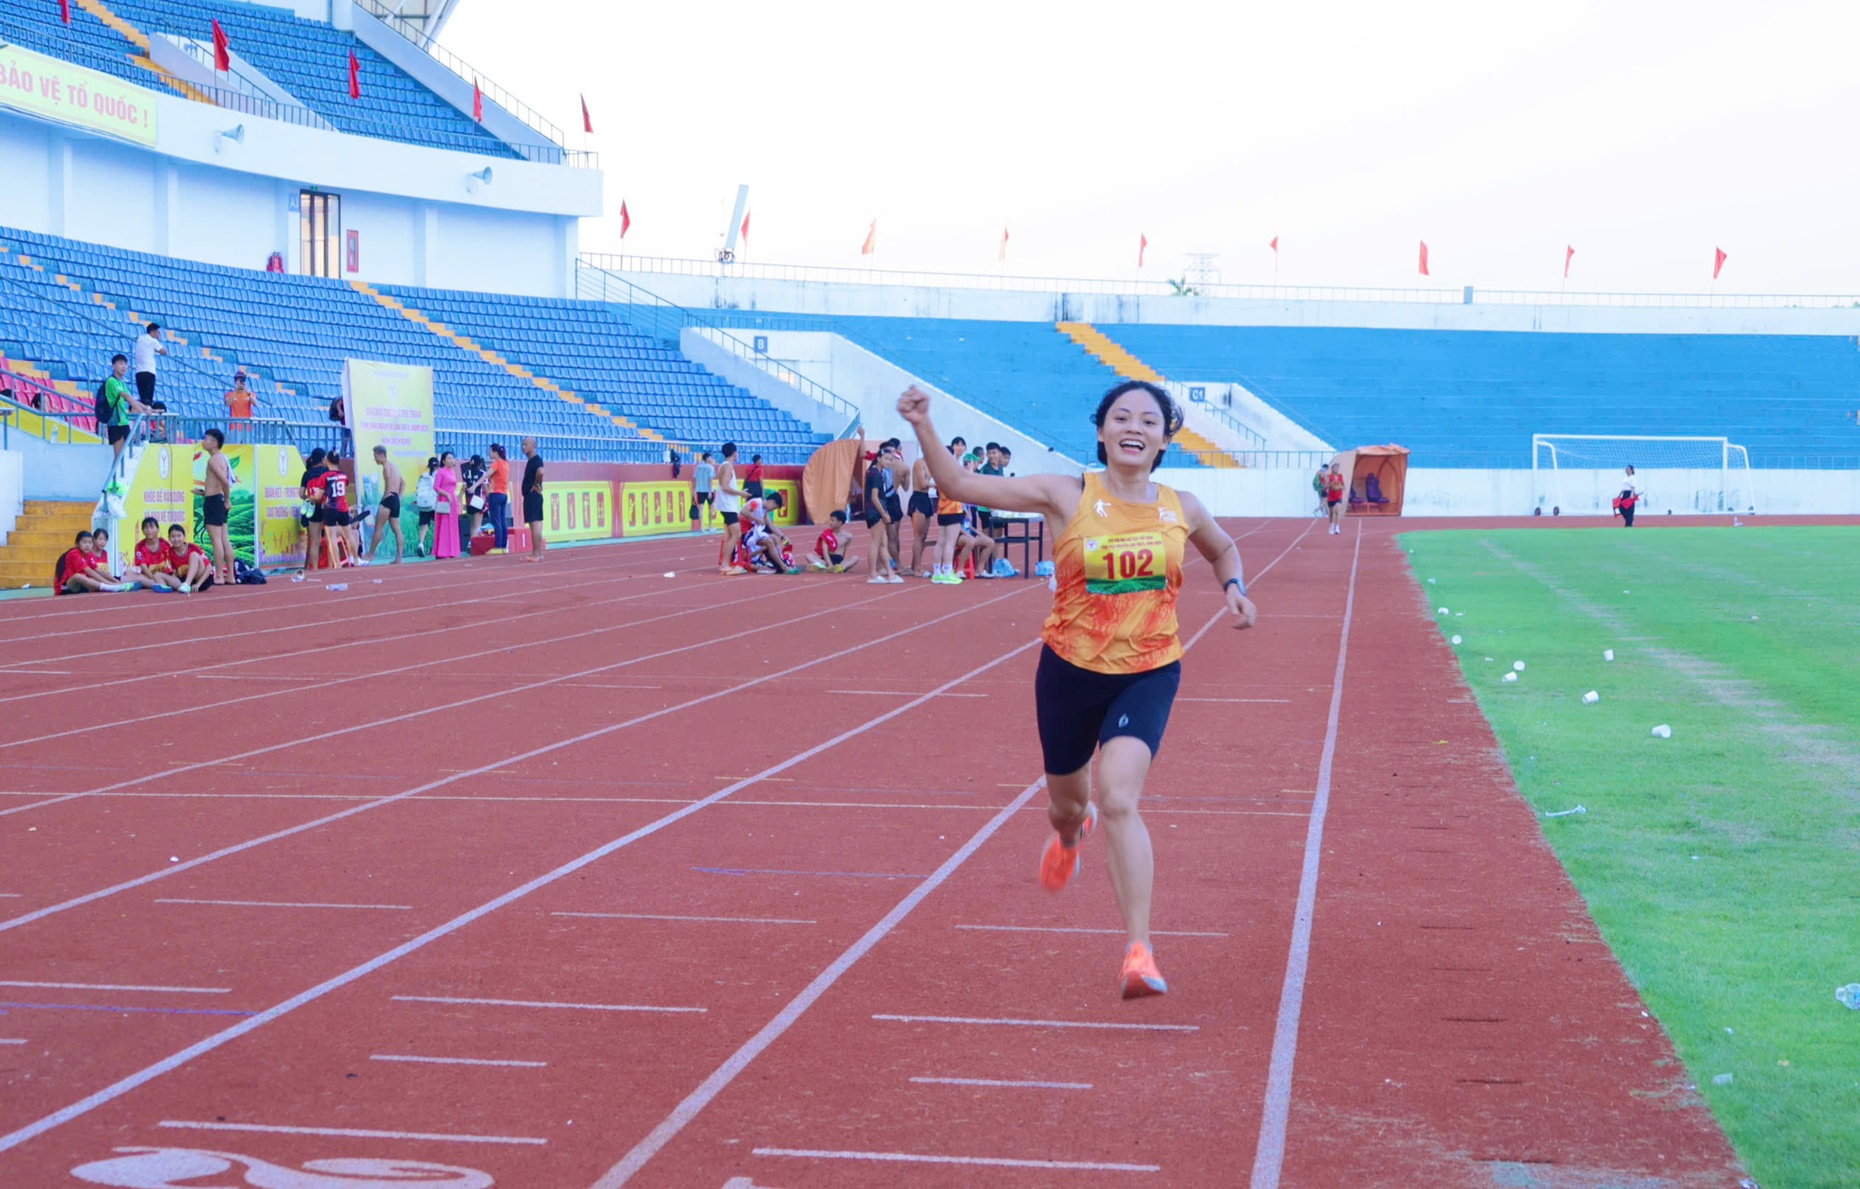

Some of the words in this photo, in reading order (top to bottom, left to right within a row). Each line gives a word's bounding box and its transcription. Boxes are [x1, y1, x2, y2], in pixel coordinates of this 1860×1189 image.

[0, 60, 34, 93] BẢO
[39, 75, 62, 106] VỆ
[67, 80, 89, 109] TỔ
[93, 95, 138, 125] QUỐC
[143, 108, 149, 129] !
[757, 338, 765, 350] B
[1191, 389, 1204, 400] C1
[331, 481, 345, 498] 19
[1101, 549, 1154, 580] 102
